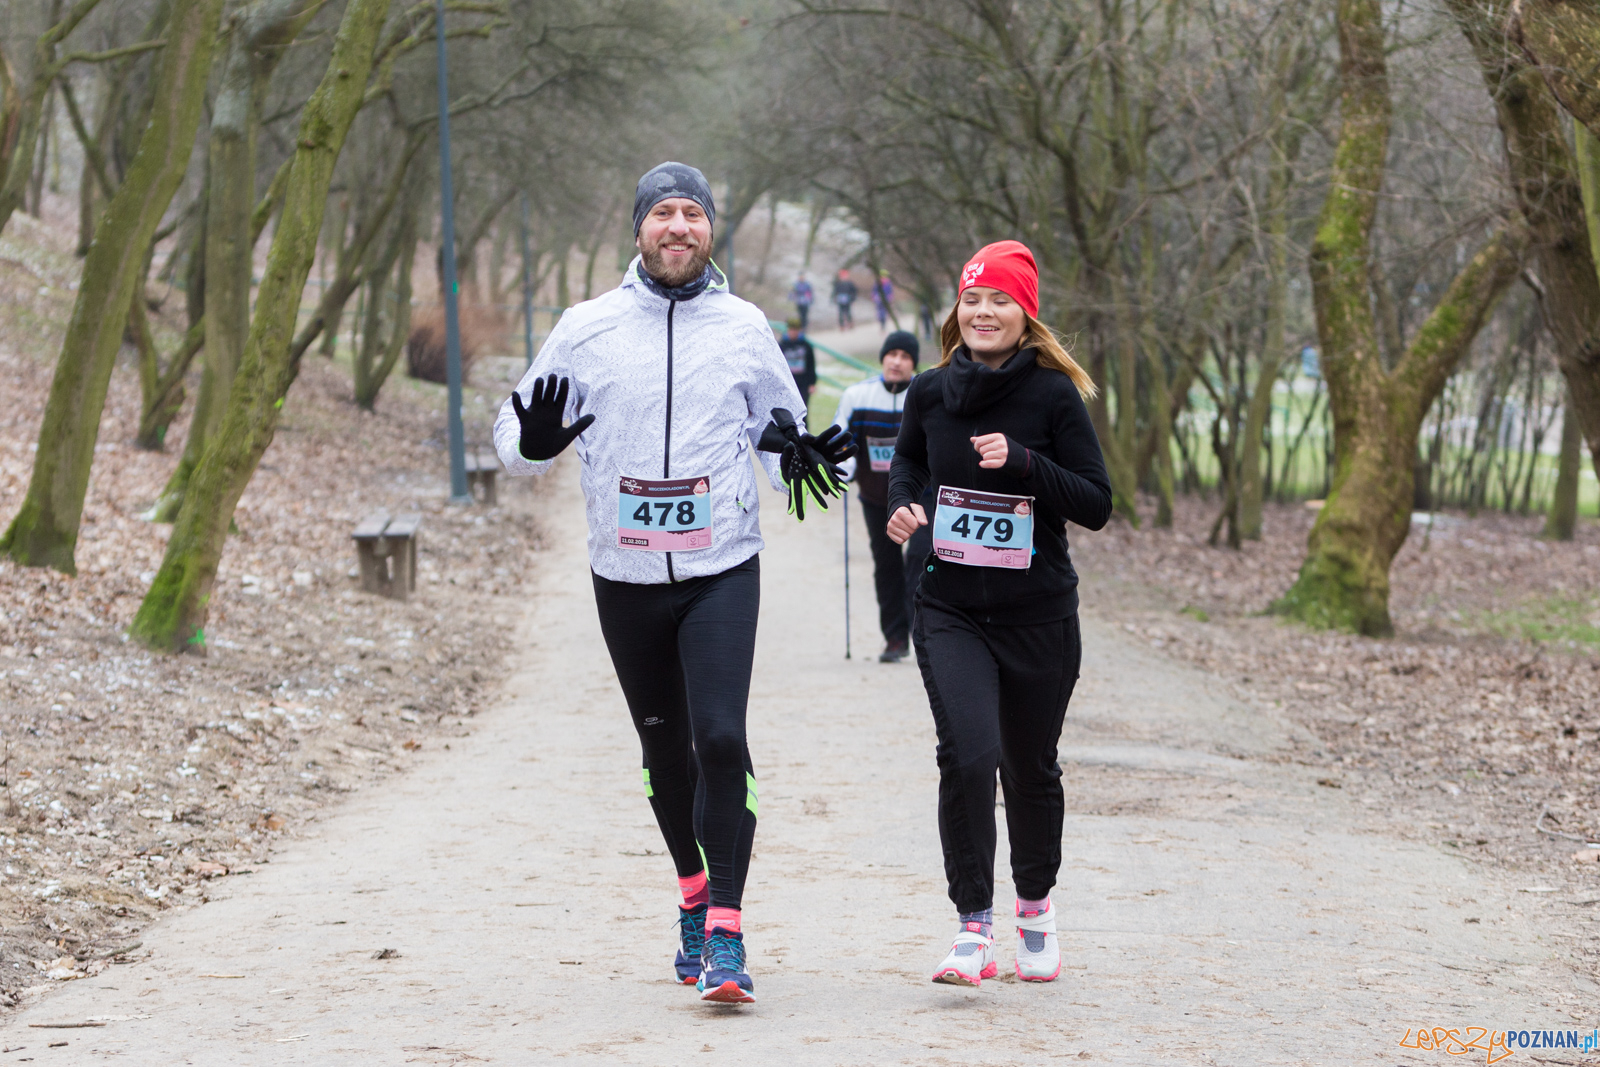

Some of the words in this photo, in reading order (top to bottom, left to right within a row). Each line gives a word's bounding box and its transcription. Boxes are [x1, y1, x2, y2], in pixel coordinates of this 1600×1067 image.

[633, 501, 695, 526] 478
[951, 513, 1014, 542] 479
[621, 537, 648, 546] 11.02.2018
[938, 548, 963, 558] 11.02.2018
